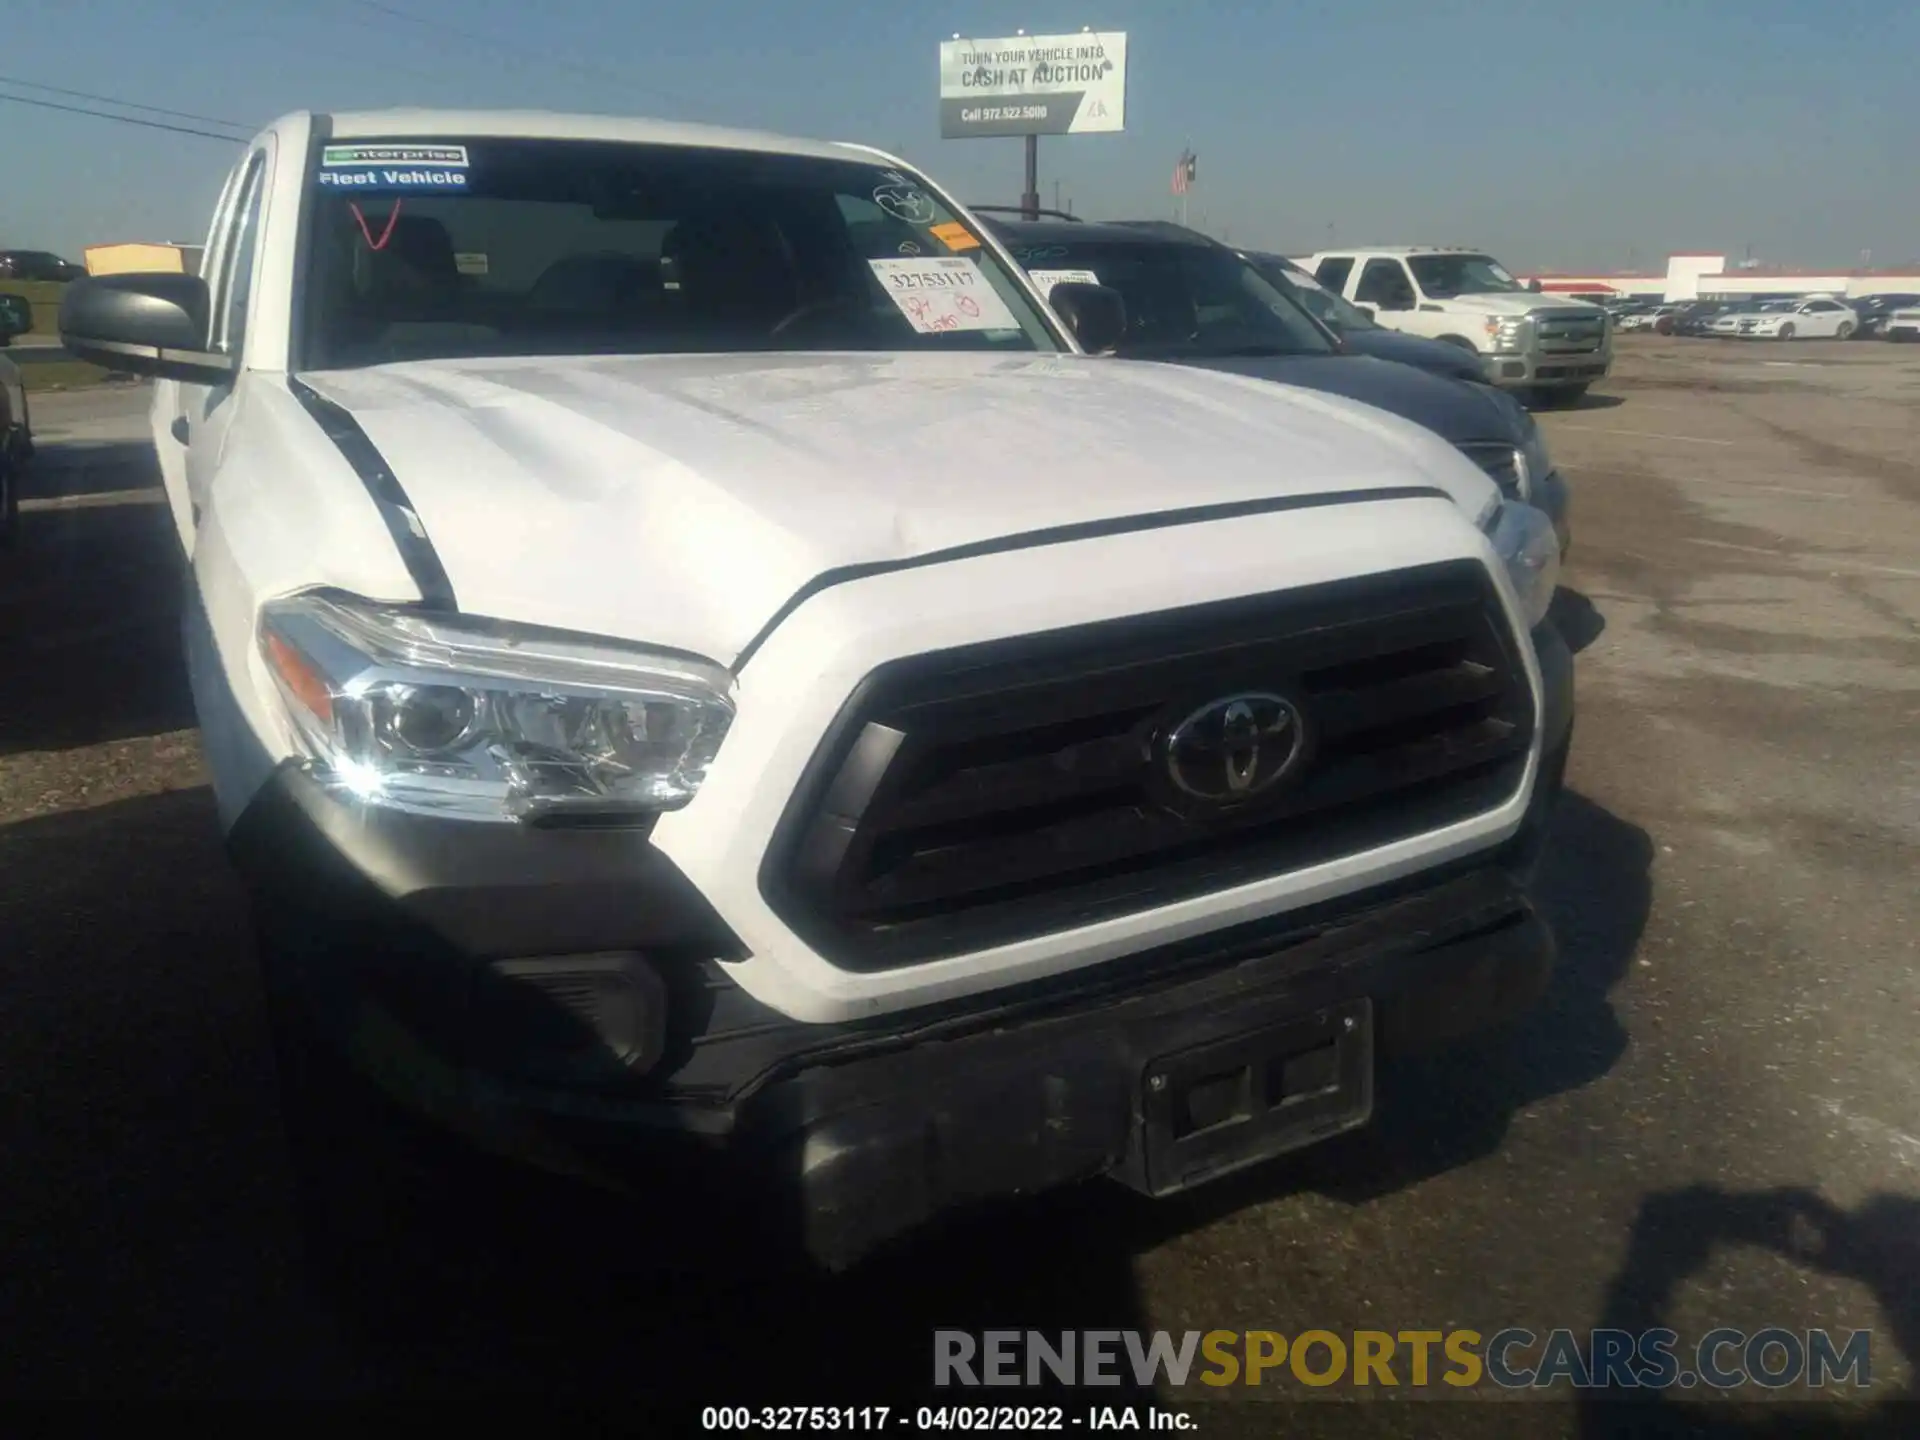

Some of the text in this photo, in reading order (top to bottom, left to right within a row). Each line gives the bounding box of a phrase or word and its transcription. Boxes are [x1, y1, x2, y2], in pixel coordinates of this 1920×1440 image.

[962, 45, 1104, 65] TURN YOUR VEHICLE INTO
[961, 64, 1103, 87] CASH AT AUCTION
[961, 107, 980, 121] Call
[319, 170, 466, 185] Fleet Vehicle
[889, 272, 974, 288] 32753117
